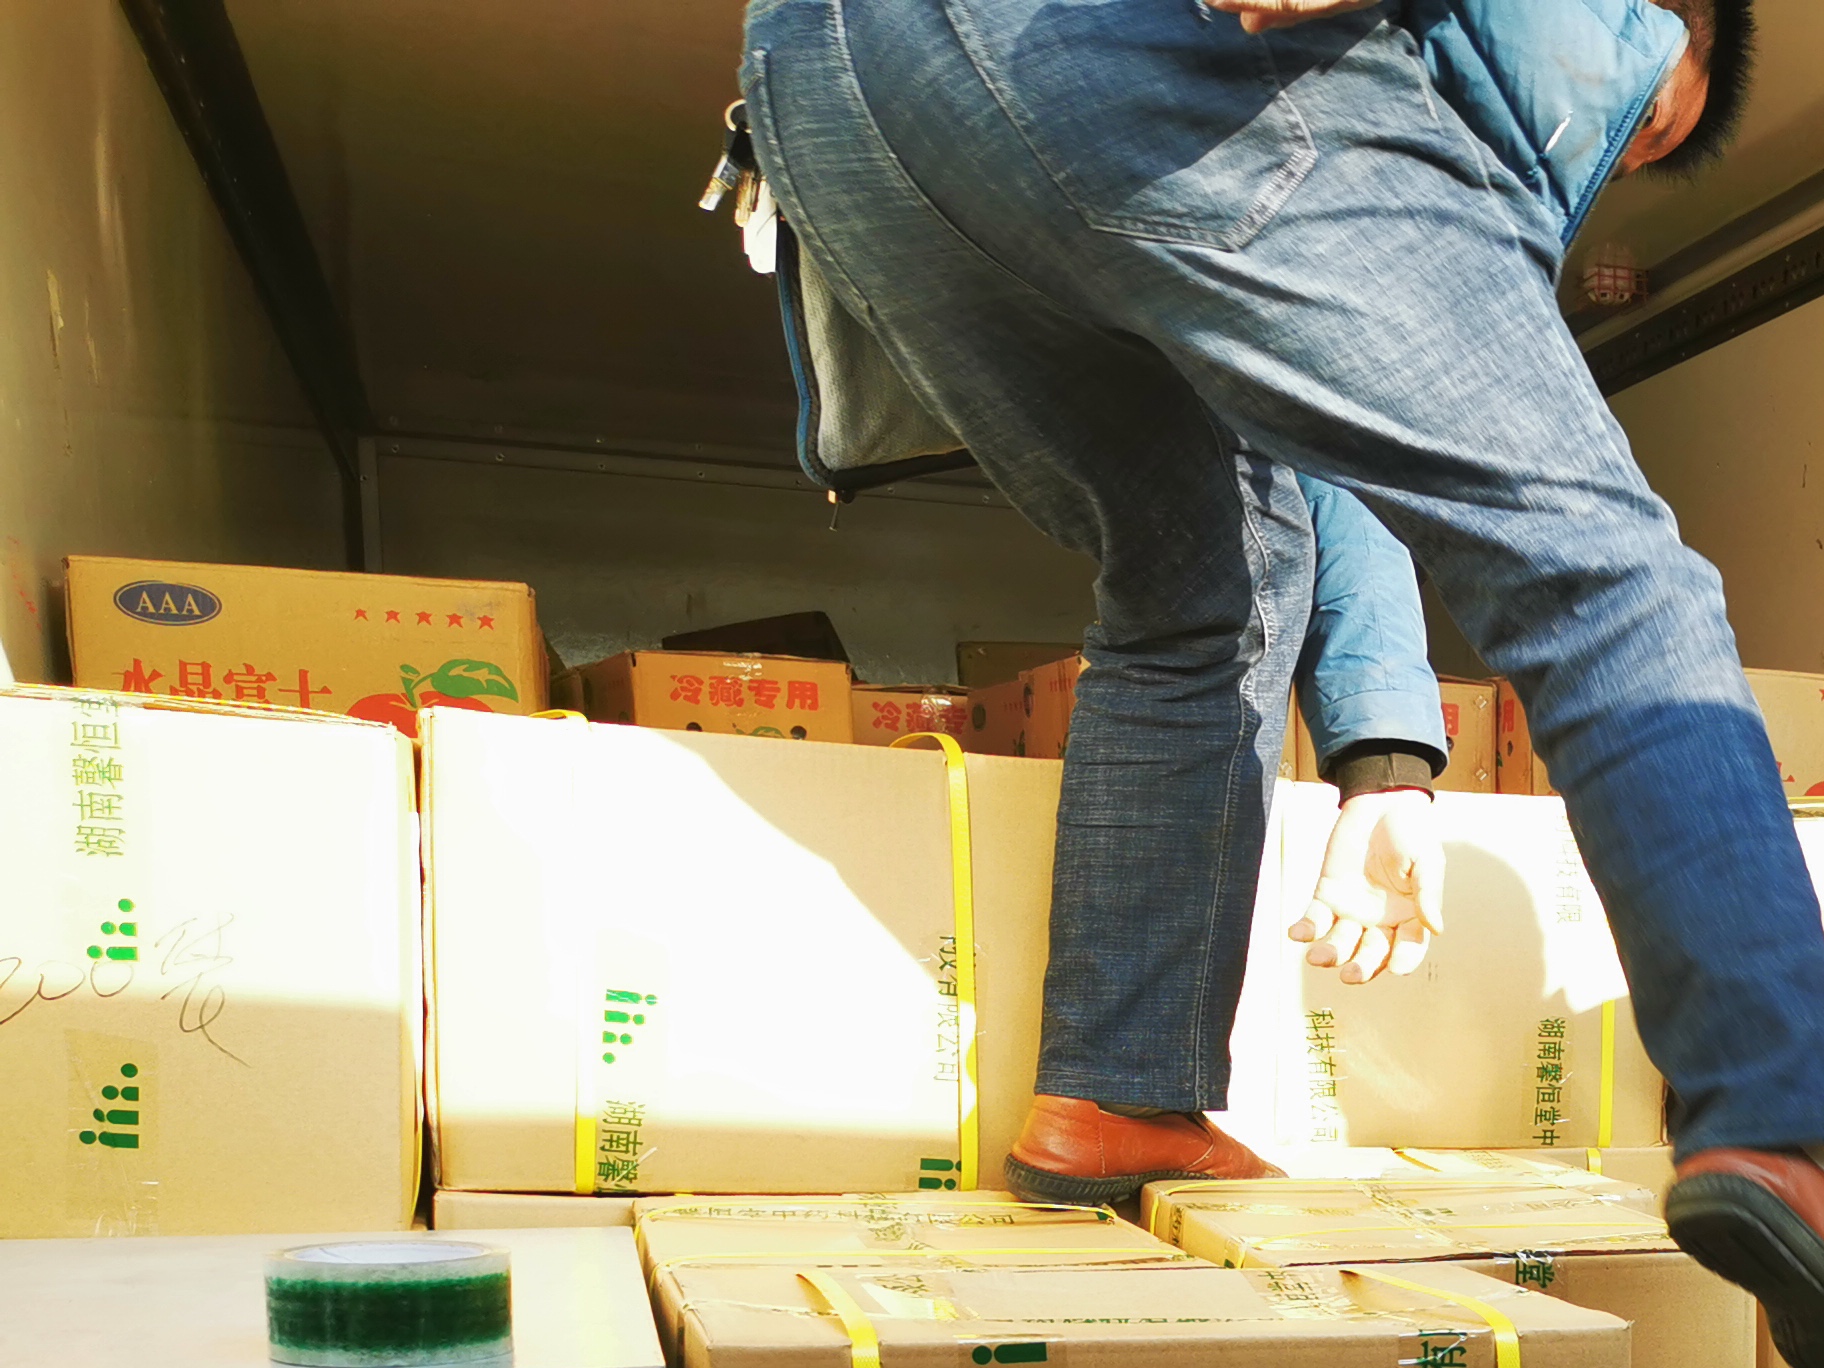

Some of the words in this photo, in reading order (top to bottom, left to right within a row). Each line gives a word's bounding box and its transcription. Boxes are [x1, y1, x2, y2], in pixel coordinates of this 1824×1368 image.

[135, 591, 202, 616] AAA
[669, 675, 820, 711] 冷藏专用
[1532, 1017, 1567, 1148] 湖南馨恒堂中
